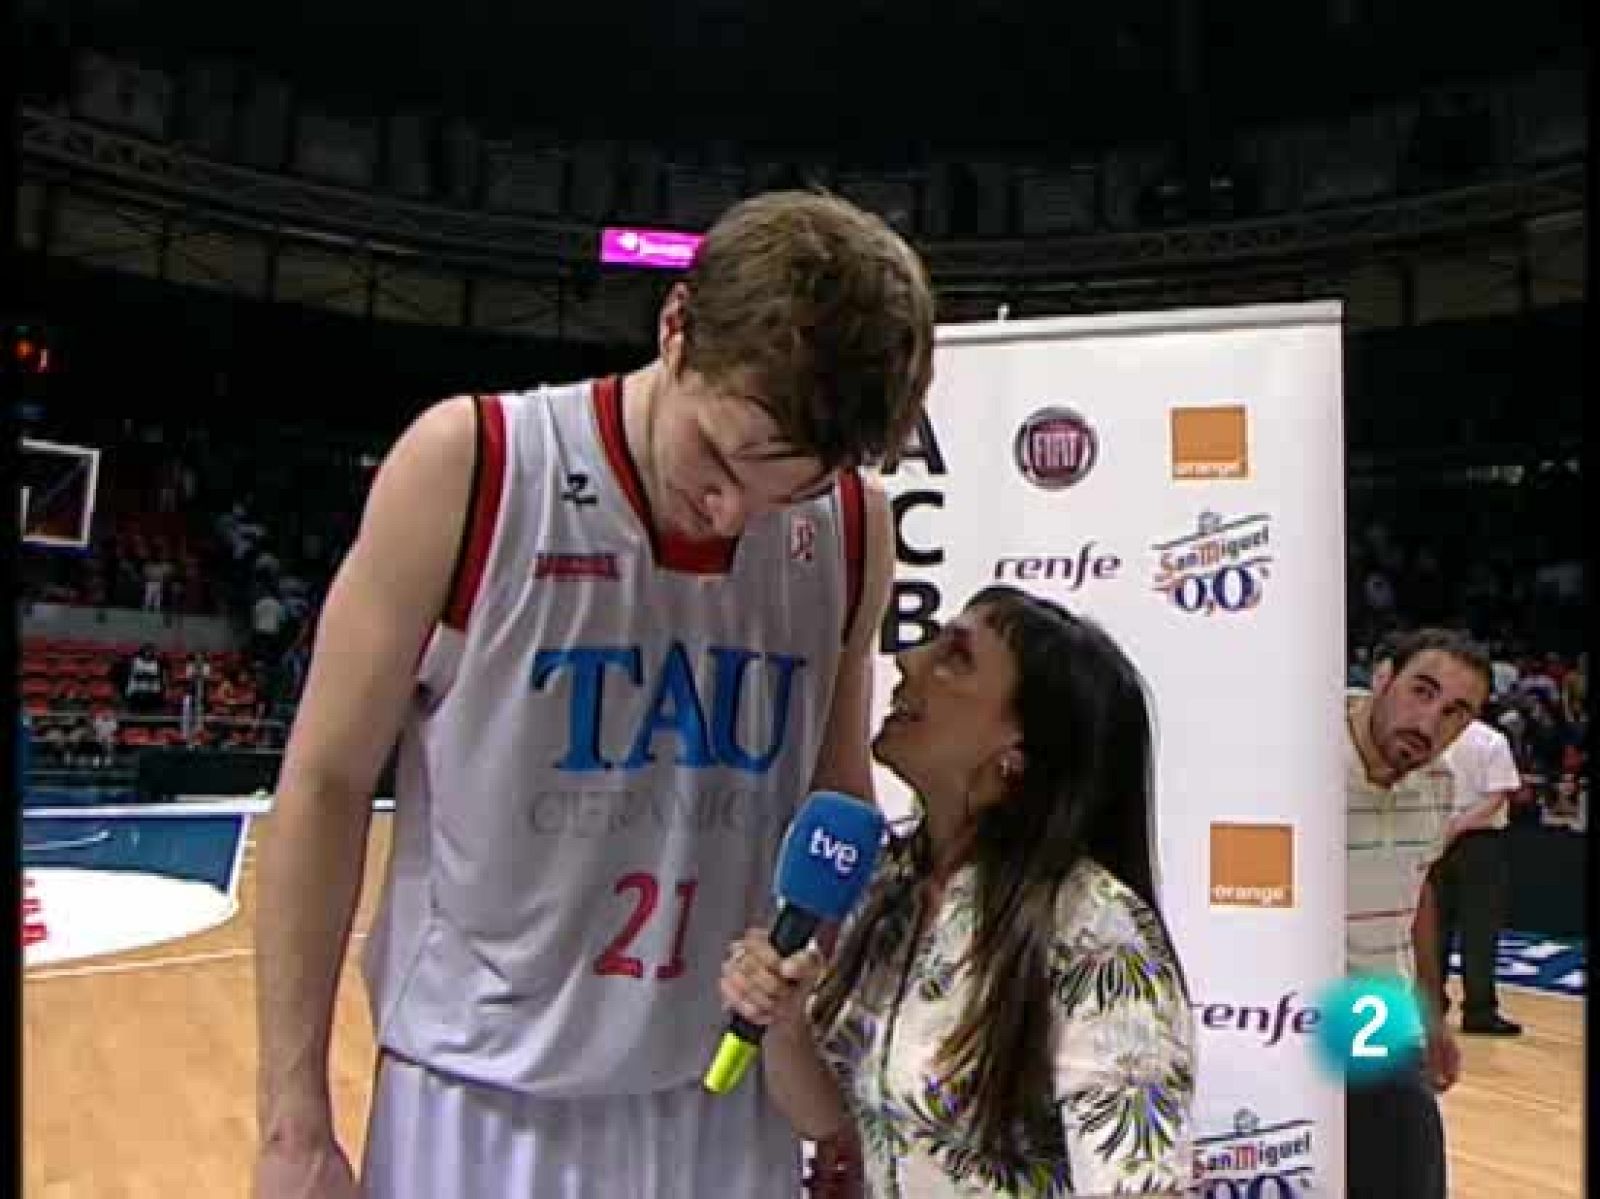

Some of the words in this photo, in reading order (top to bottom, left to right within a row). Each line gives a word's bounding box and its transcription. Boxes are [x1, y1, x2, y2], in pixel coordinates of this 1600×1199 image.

[1034, 431, 1079, 467] FIAT
[994, 541, 1121, 591] renfe
[530, 638, 807, 773] TAU
[808, 825, 860, 876] tve
[1213, 884, 1285, 908] orange
[593, 871, 699, 980] 21
[1189, 990, 1321, 1047] enfe
